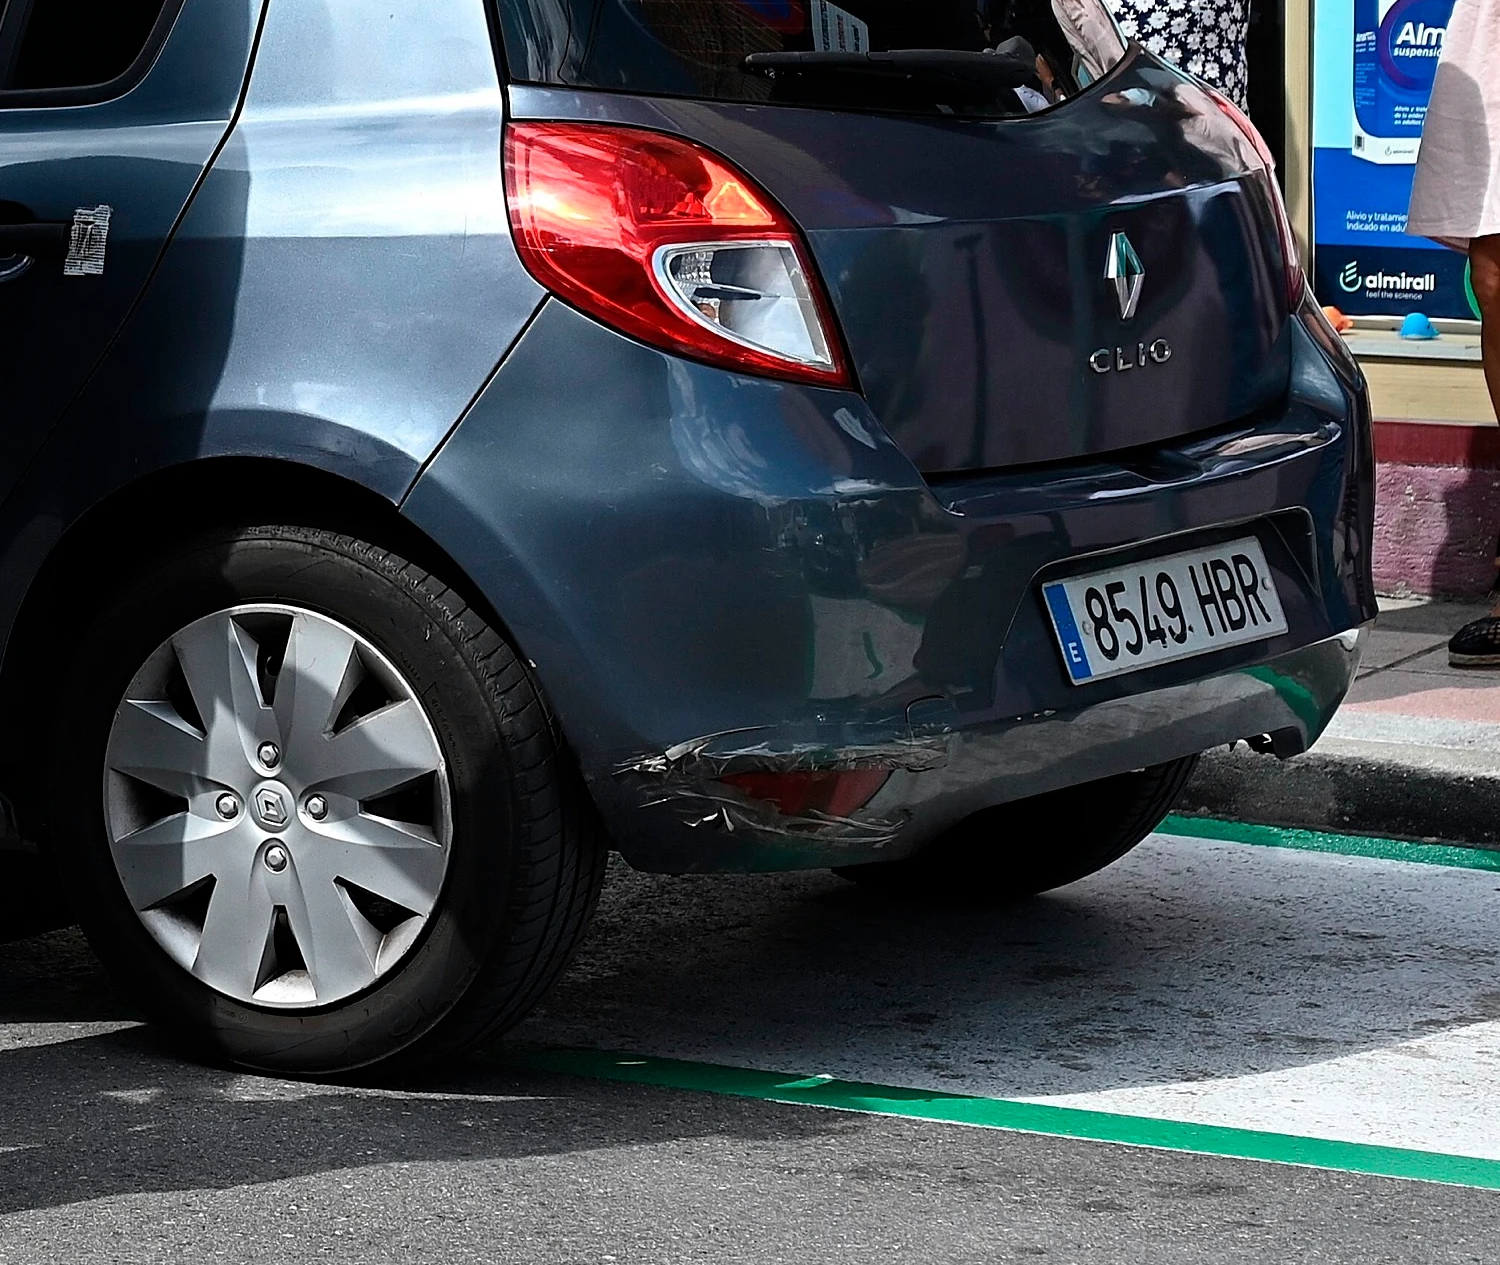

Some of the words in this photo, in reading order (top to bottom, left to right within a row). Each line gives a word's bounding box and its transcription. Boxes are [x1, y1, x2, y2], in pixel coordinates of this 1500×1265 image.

[1346, 210, 1367, 221] Alivio
[1346, 221, 1379, 232] Indicado
[1380, 223, 1390, 232] en
[1365, 271, 1435, 291] almirall
[1366, 290, 1381, 298] feel
[1381, 290, 1394, 299] the
[1394, 291, 1423, 300] science
[1089, 338, 1173, 373] CLIO
[1085, 571, 1189, 661] 8549
[1188, 553, 1272, 638] HBR
[1069, 641, 1082, 663] E
